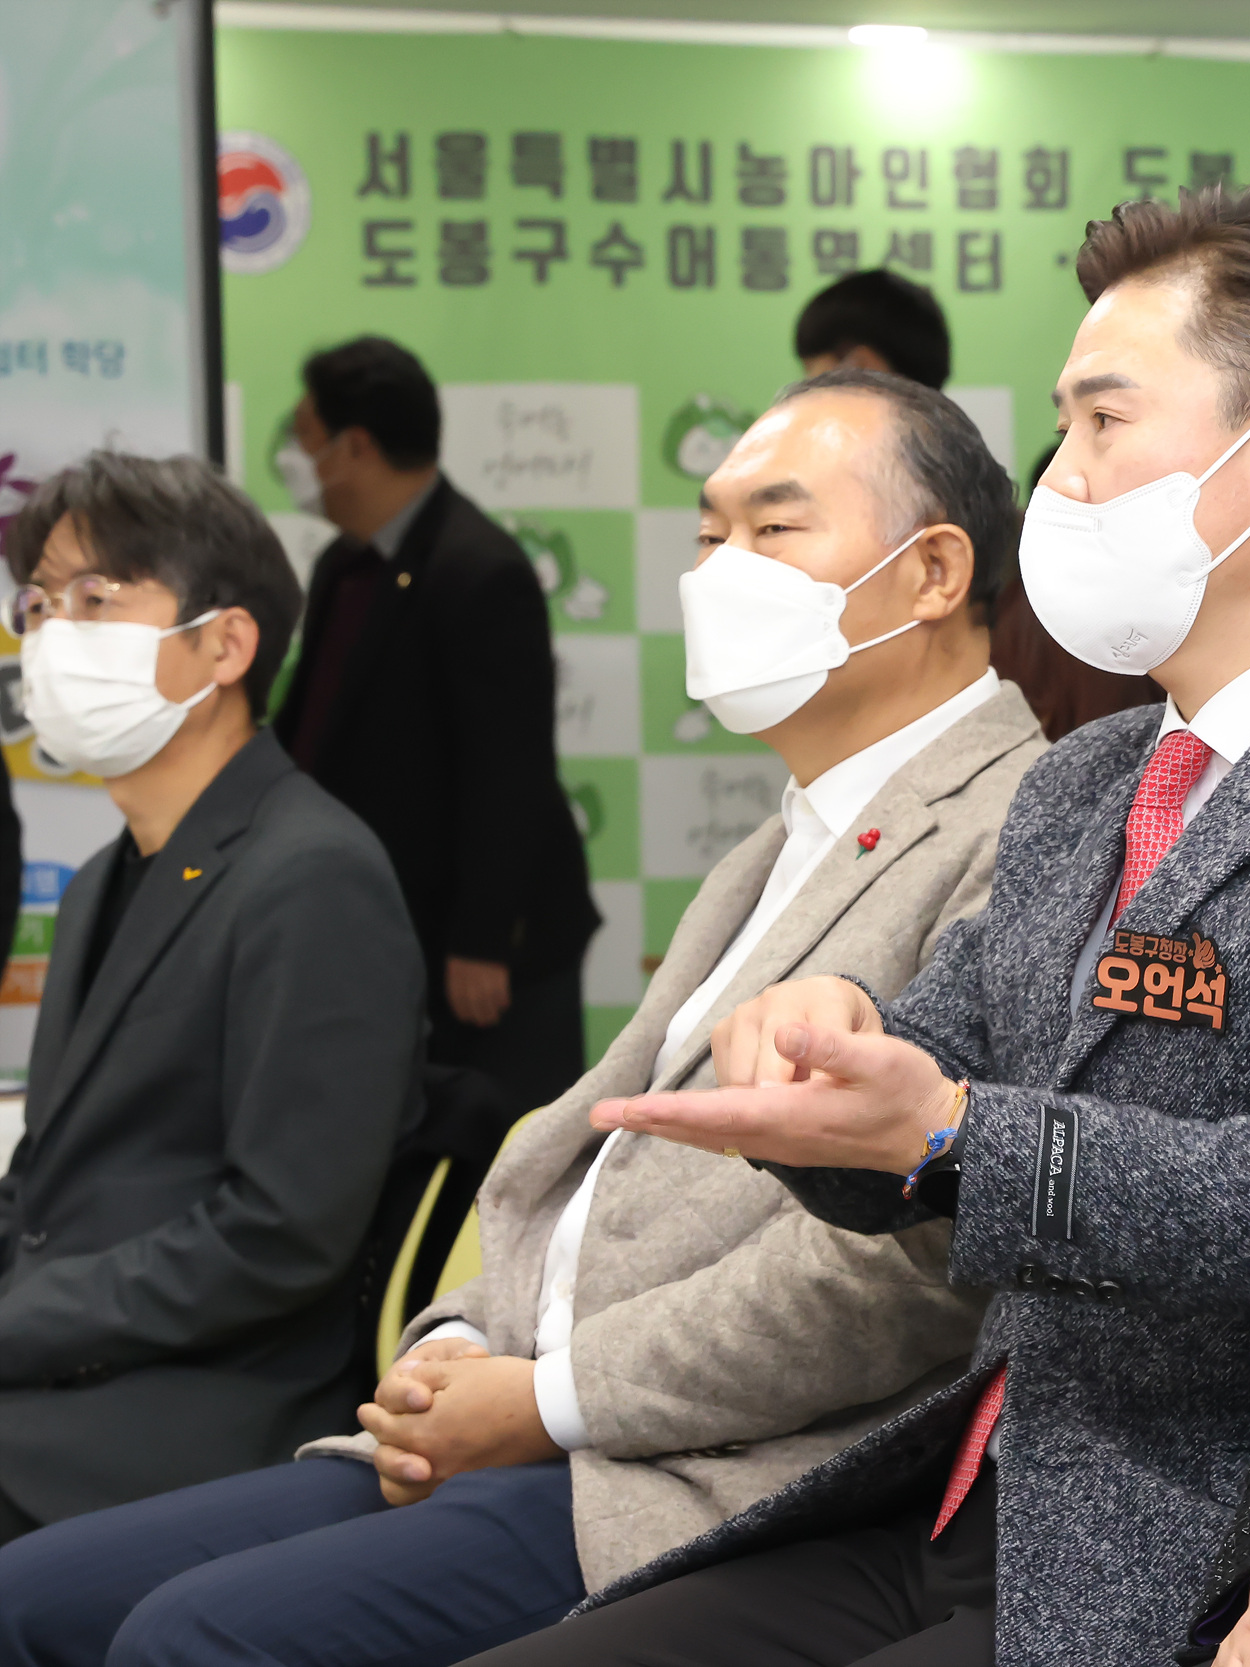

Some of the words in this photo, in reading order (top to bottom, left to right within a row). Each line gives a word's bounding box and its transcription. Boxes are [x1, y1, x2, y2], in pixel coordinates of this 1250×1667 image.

[356, 130, 1069, 211] 서울특별시농아인협회
[361, 218, 1003, 293] 도봉구수어통역센터
[1114, 931, 1187, 964] 도봉구청장
[1093, 955, 1226, 1030] 오언석
[1049, 1118, 1066, 1176] ALPACA
[1046, 1198, 1054, 1217] wool
[1047, 1179, 1056, 1197] and
